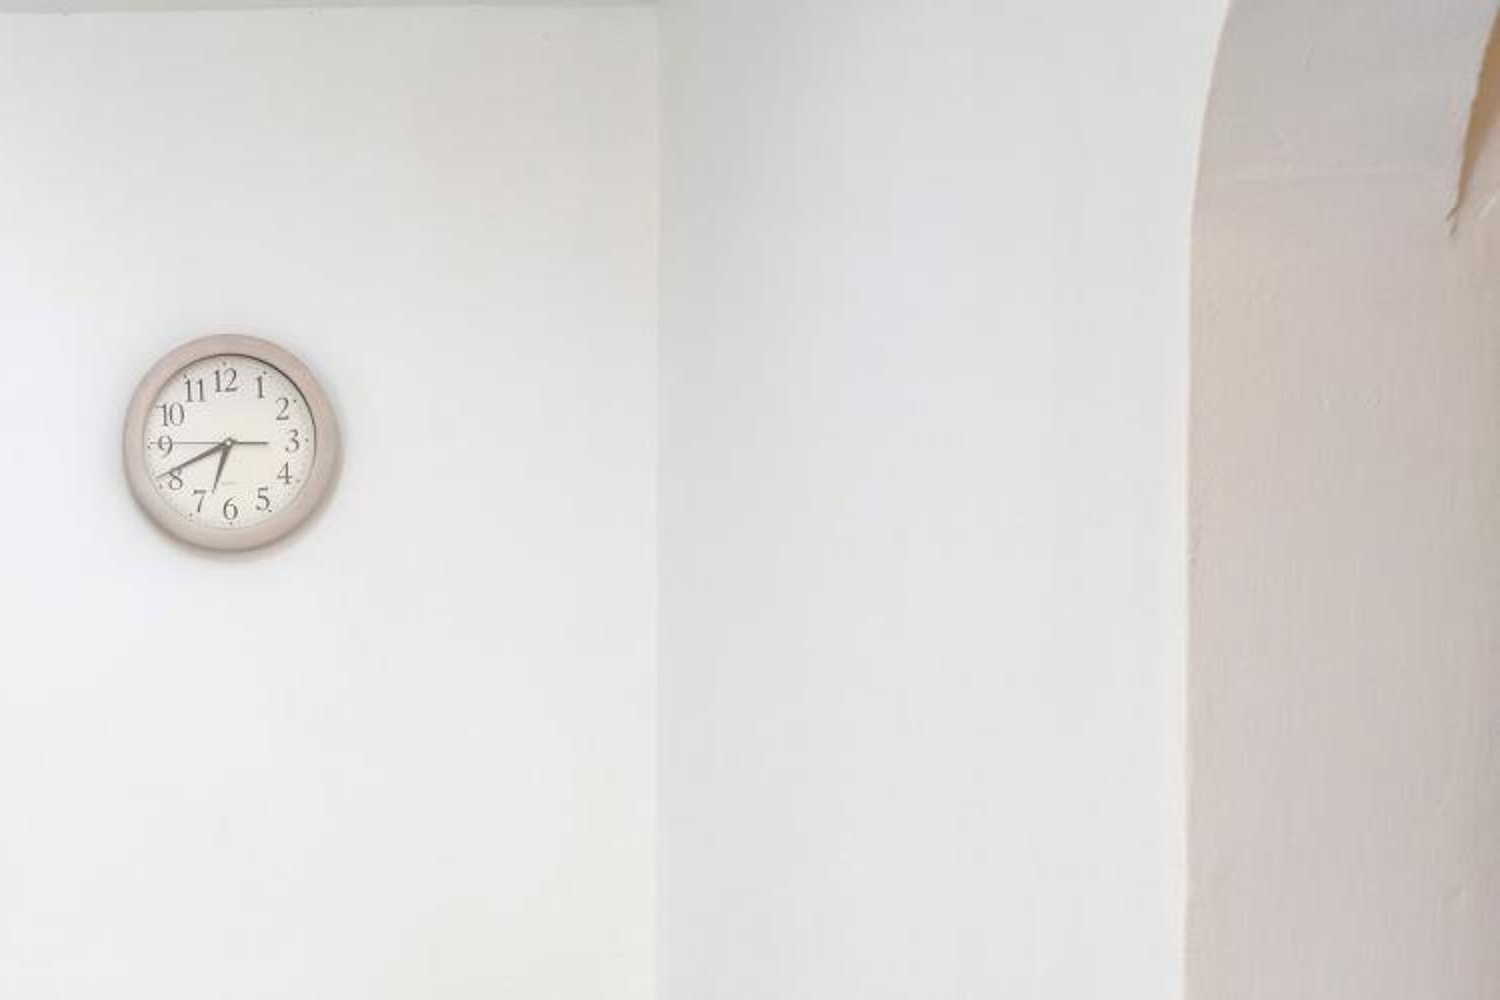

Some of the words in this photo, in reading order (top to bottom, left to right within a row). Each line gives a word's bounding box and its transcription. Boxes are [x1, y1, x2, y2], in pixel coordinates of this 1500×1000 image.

[184, 378, 206, 402] 11
[214, 367, 238, 393] 12
[255, 375, 265, 399] 1
[157, 402, 185, 427] 10
[275, 397, 290, 421] 2
[157, 435, 173, 457] 9
[285, 429, 299, 452] 3
[167, 468, 184, 491] 8
[277, 462, 292, 485] 4
[193, 490, 207, 513] 7
[222, 497, 238, 521] 6
[255, 487, 271, 512] 5
